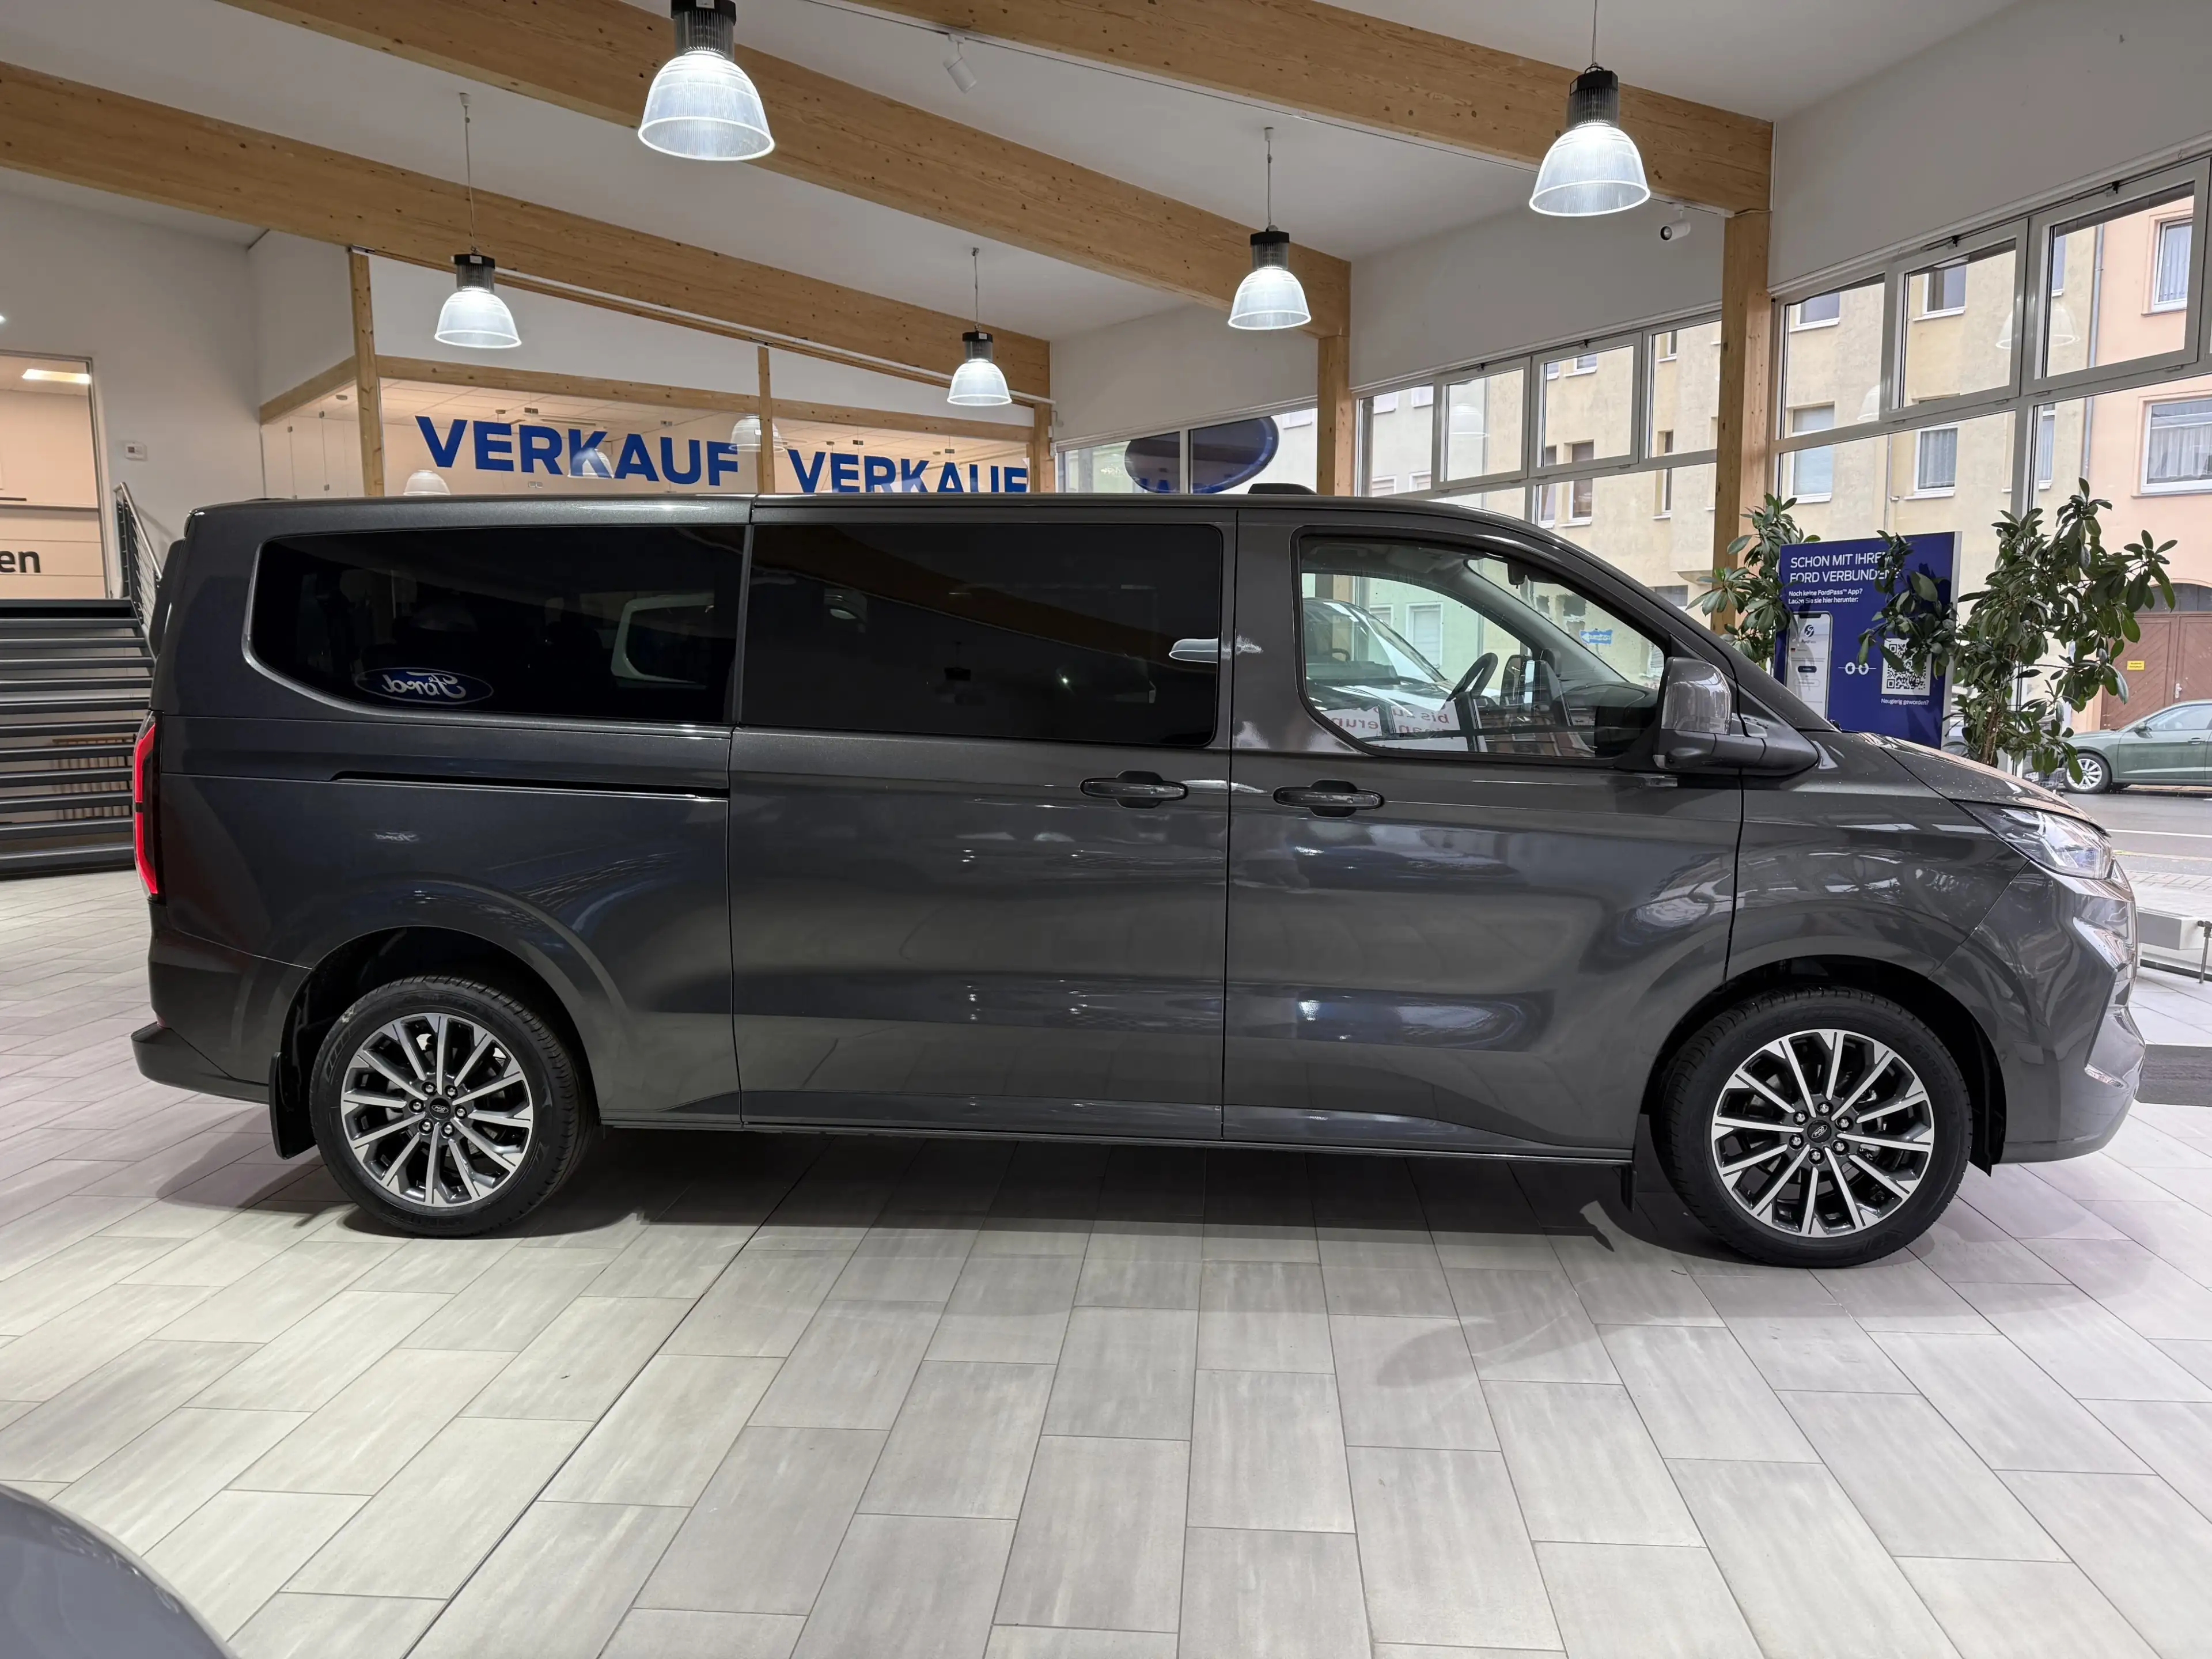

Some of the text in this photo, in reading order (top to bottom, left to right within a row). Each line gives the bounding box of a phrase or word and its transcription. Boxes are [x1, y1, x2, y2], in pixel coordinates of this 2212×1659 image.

[415, 415, 738, 486] VERKAUF
[787, 449, 1027, 493] VERKAUF
[1790, 551, 1886, 568] SCHON MIT IHRE
[1790, 571, 1820, 583] FORD
